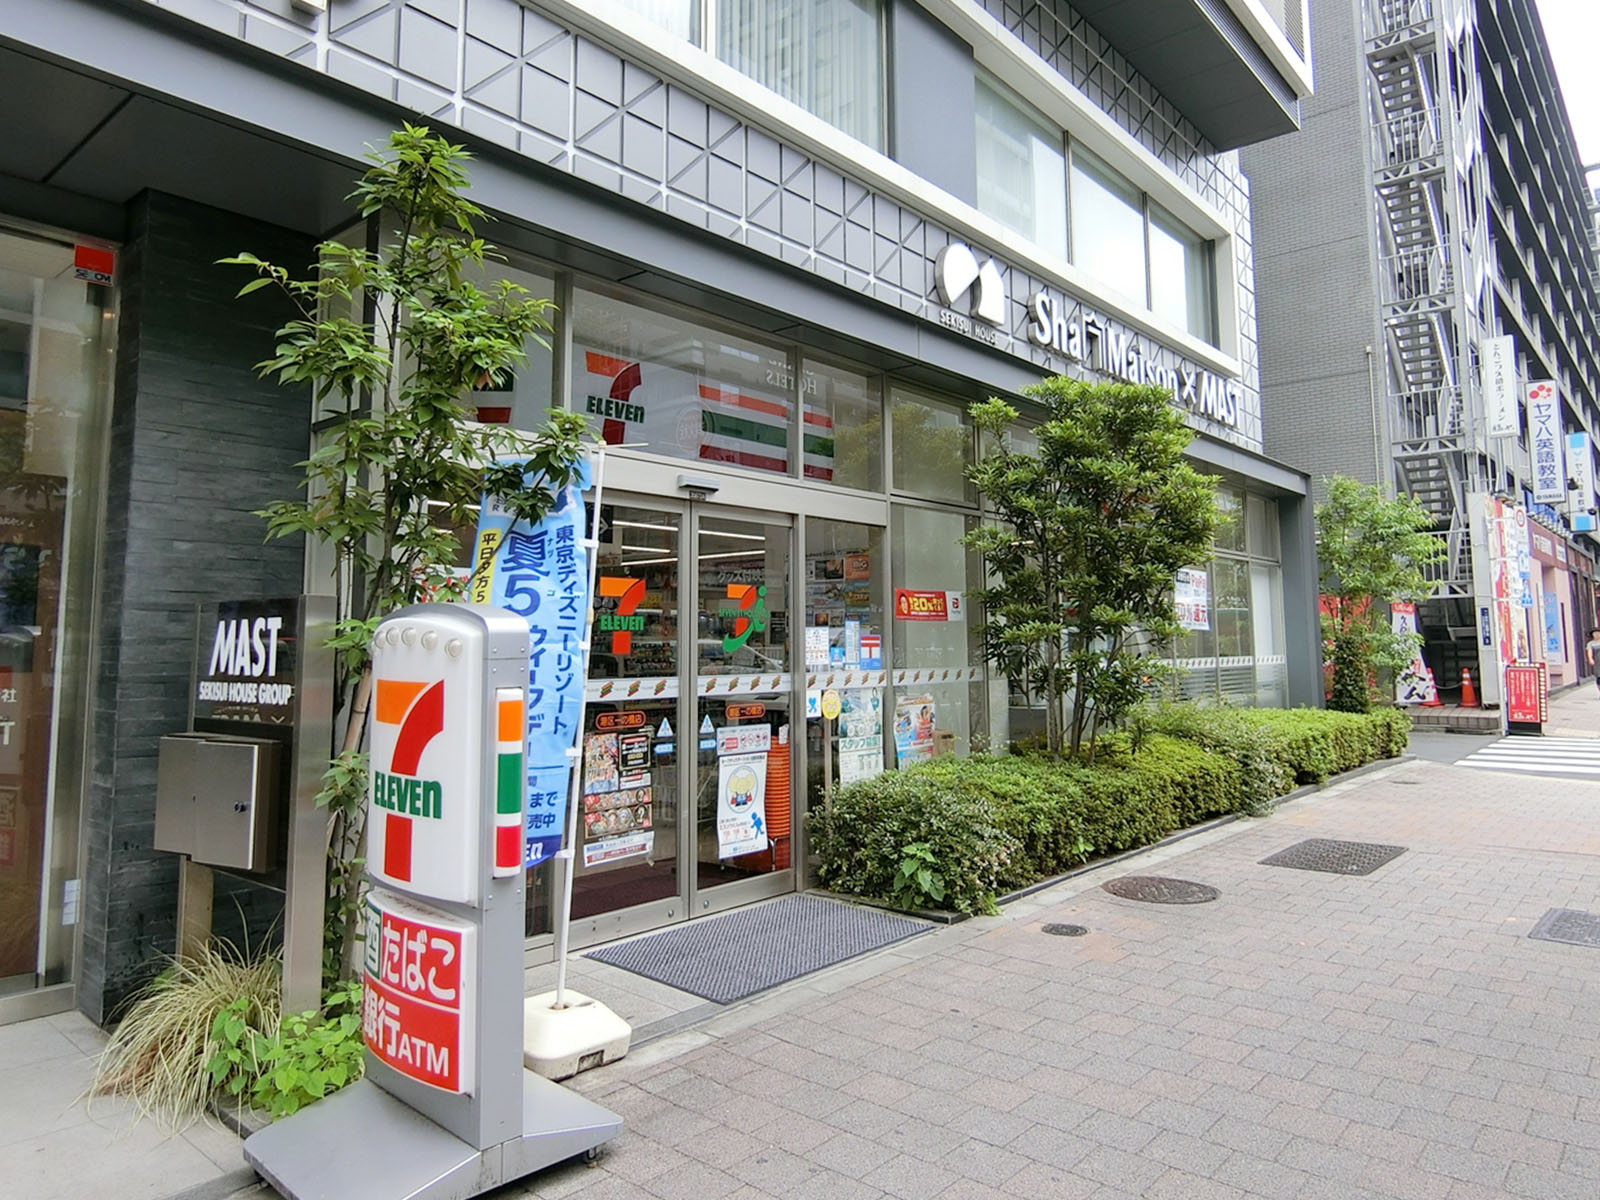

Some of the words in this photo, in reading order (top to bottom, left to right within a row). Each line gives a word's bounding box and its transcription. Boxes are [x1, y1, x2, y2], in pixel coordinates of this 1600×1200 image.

[75, 268, 112, 283] SEOM
[940, 310, 972, 334] SEKISUI
[975, 323, 999, 345] HOUSE
[1199, 371, 1243, 429] MAST
[1533, 403, 1557, 490] ヤマハ英語教室
[208, 616, 282, 677] MAST
[552, 524, 581, 735] 東京ディズニーリゾート
[199, 681, 228, 701] SEKISUI
[228, 682, 258, 703] HOUSE
[258, 683, 292, 705] GROUP
[530, 791, 559, 809] まで
[383, 919, 456, 1001] たばこ
[364, 984, 449, 1077] 銀行ATM
